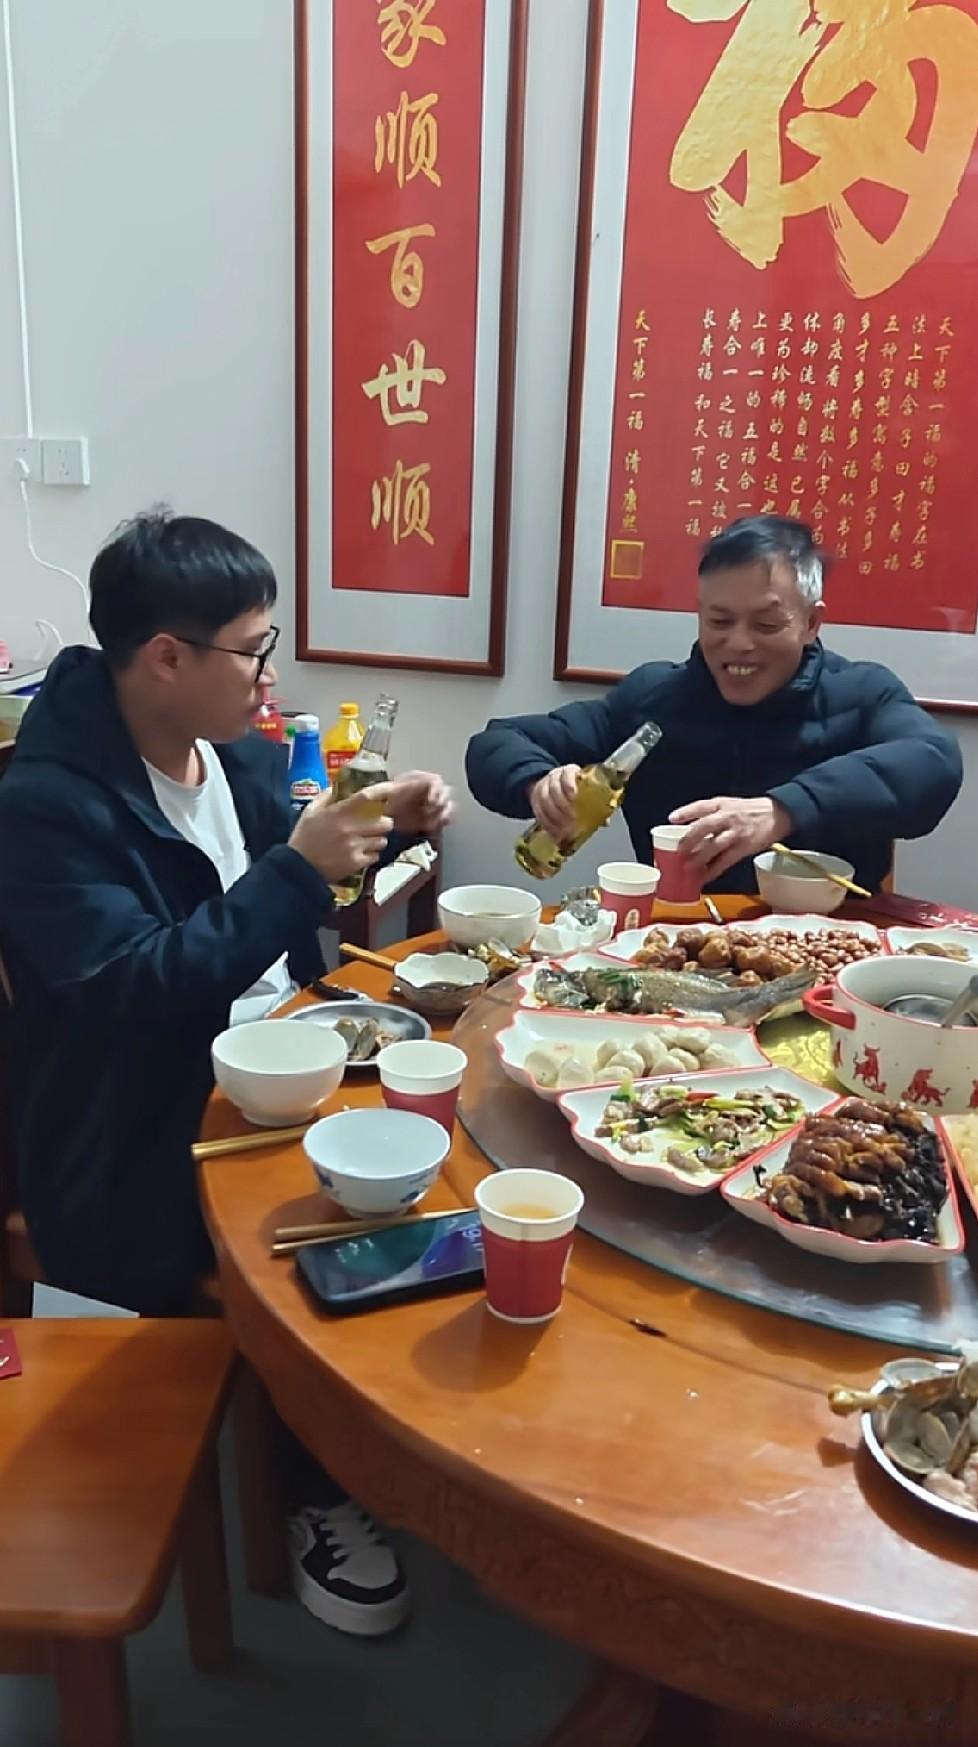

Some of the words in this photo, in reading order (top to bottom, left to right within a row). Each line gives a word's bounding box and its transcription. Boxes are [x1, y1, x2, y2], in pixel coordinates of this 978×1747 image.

[627, 308, 651, 431] 天下第一福
[685, 307, 717, 536] 长寿福和天下第一福
